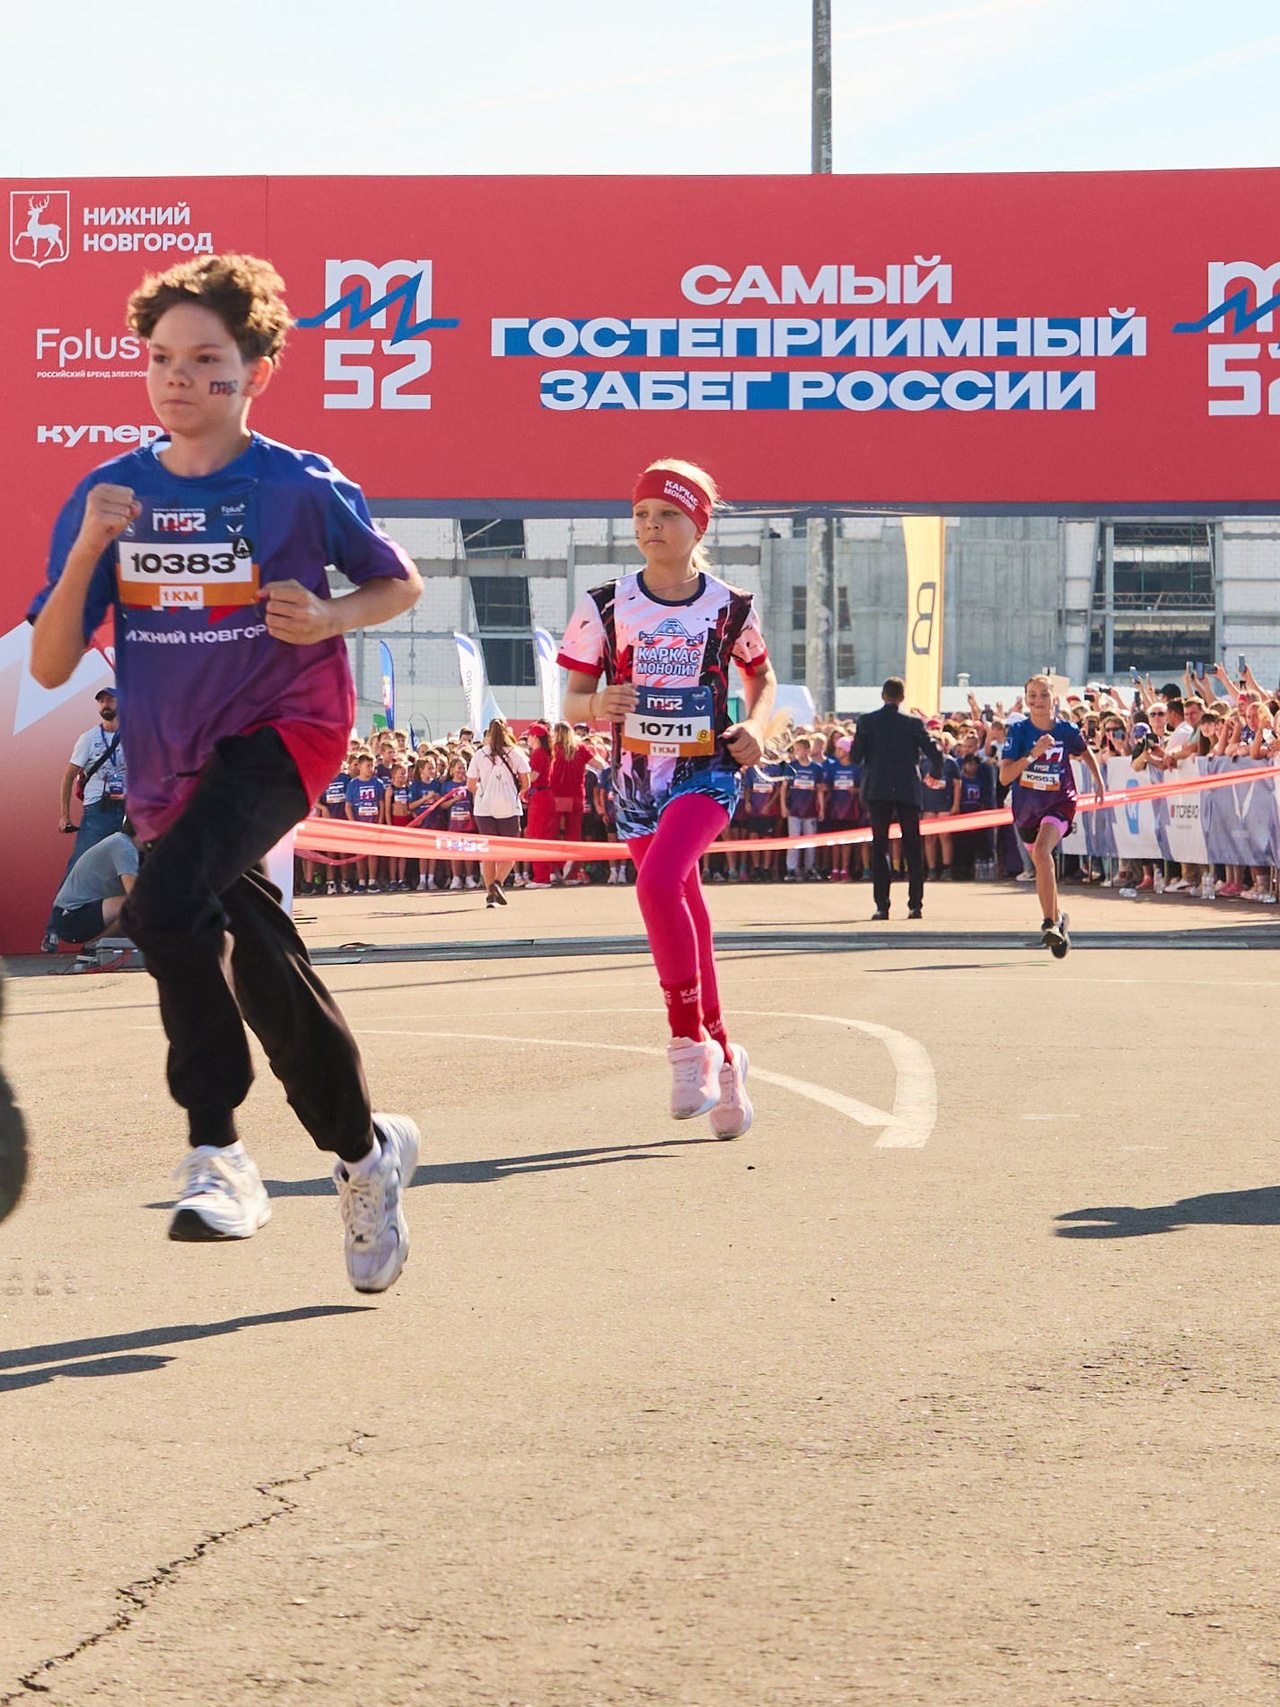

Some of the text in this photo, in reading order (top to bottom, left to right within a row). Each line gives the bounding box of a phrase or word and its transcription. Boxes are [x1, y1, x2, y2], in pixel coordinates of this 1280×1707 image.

[83, 202, 190, 225] НИЖНИЙ
[83, 233, 214, 254] НОВГОРОД
[680, 254, 953, 306] САМЫЙ
[490, 307, 1147, 358] ГОСТЕПРИИМНЫЙ
[36, 328, 141, 367] Fplus
[36, 369, 150, 379] РОССИЙСКИЙ БРЕНД ЭЛЕКТРОН
[324, 338, 432, 410] 52
[539, 369, 1096, 412] ЗАБЕГ РОССИИ
[37, 424, 164, 448] купер
[665, 480, 698, 506] КАРКАС
[130, 552, 236, 574] 10383
[125, 624, 267, 644] ИЖНИЙ НОВГОР
[637, 645, 701, 663] КАРКАС
[636, 661, 699, 677] МОНОЛИТ
[639, 721, 692, 737] 10711
